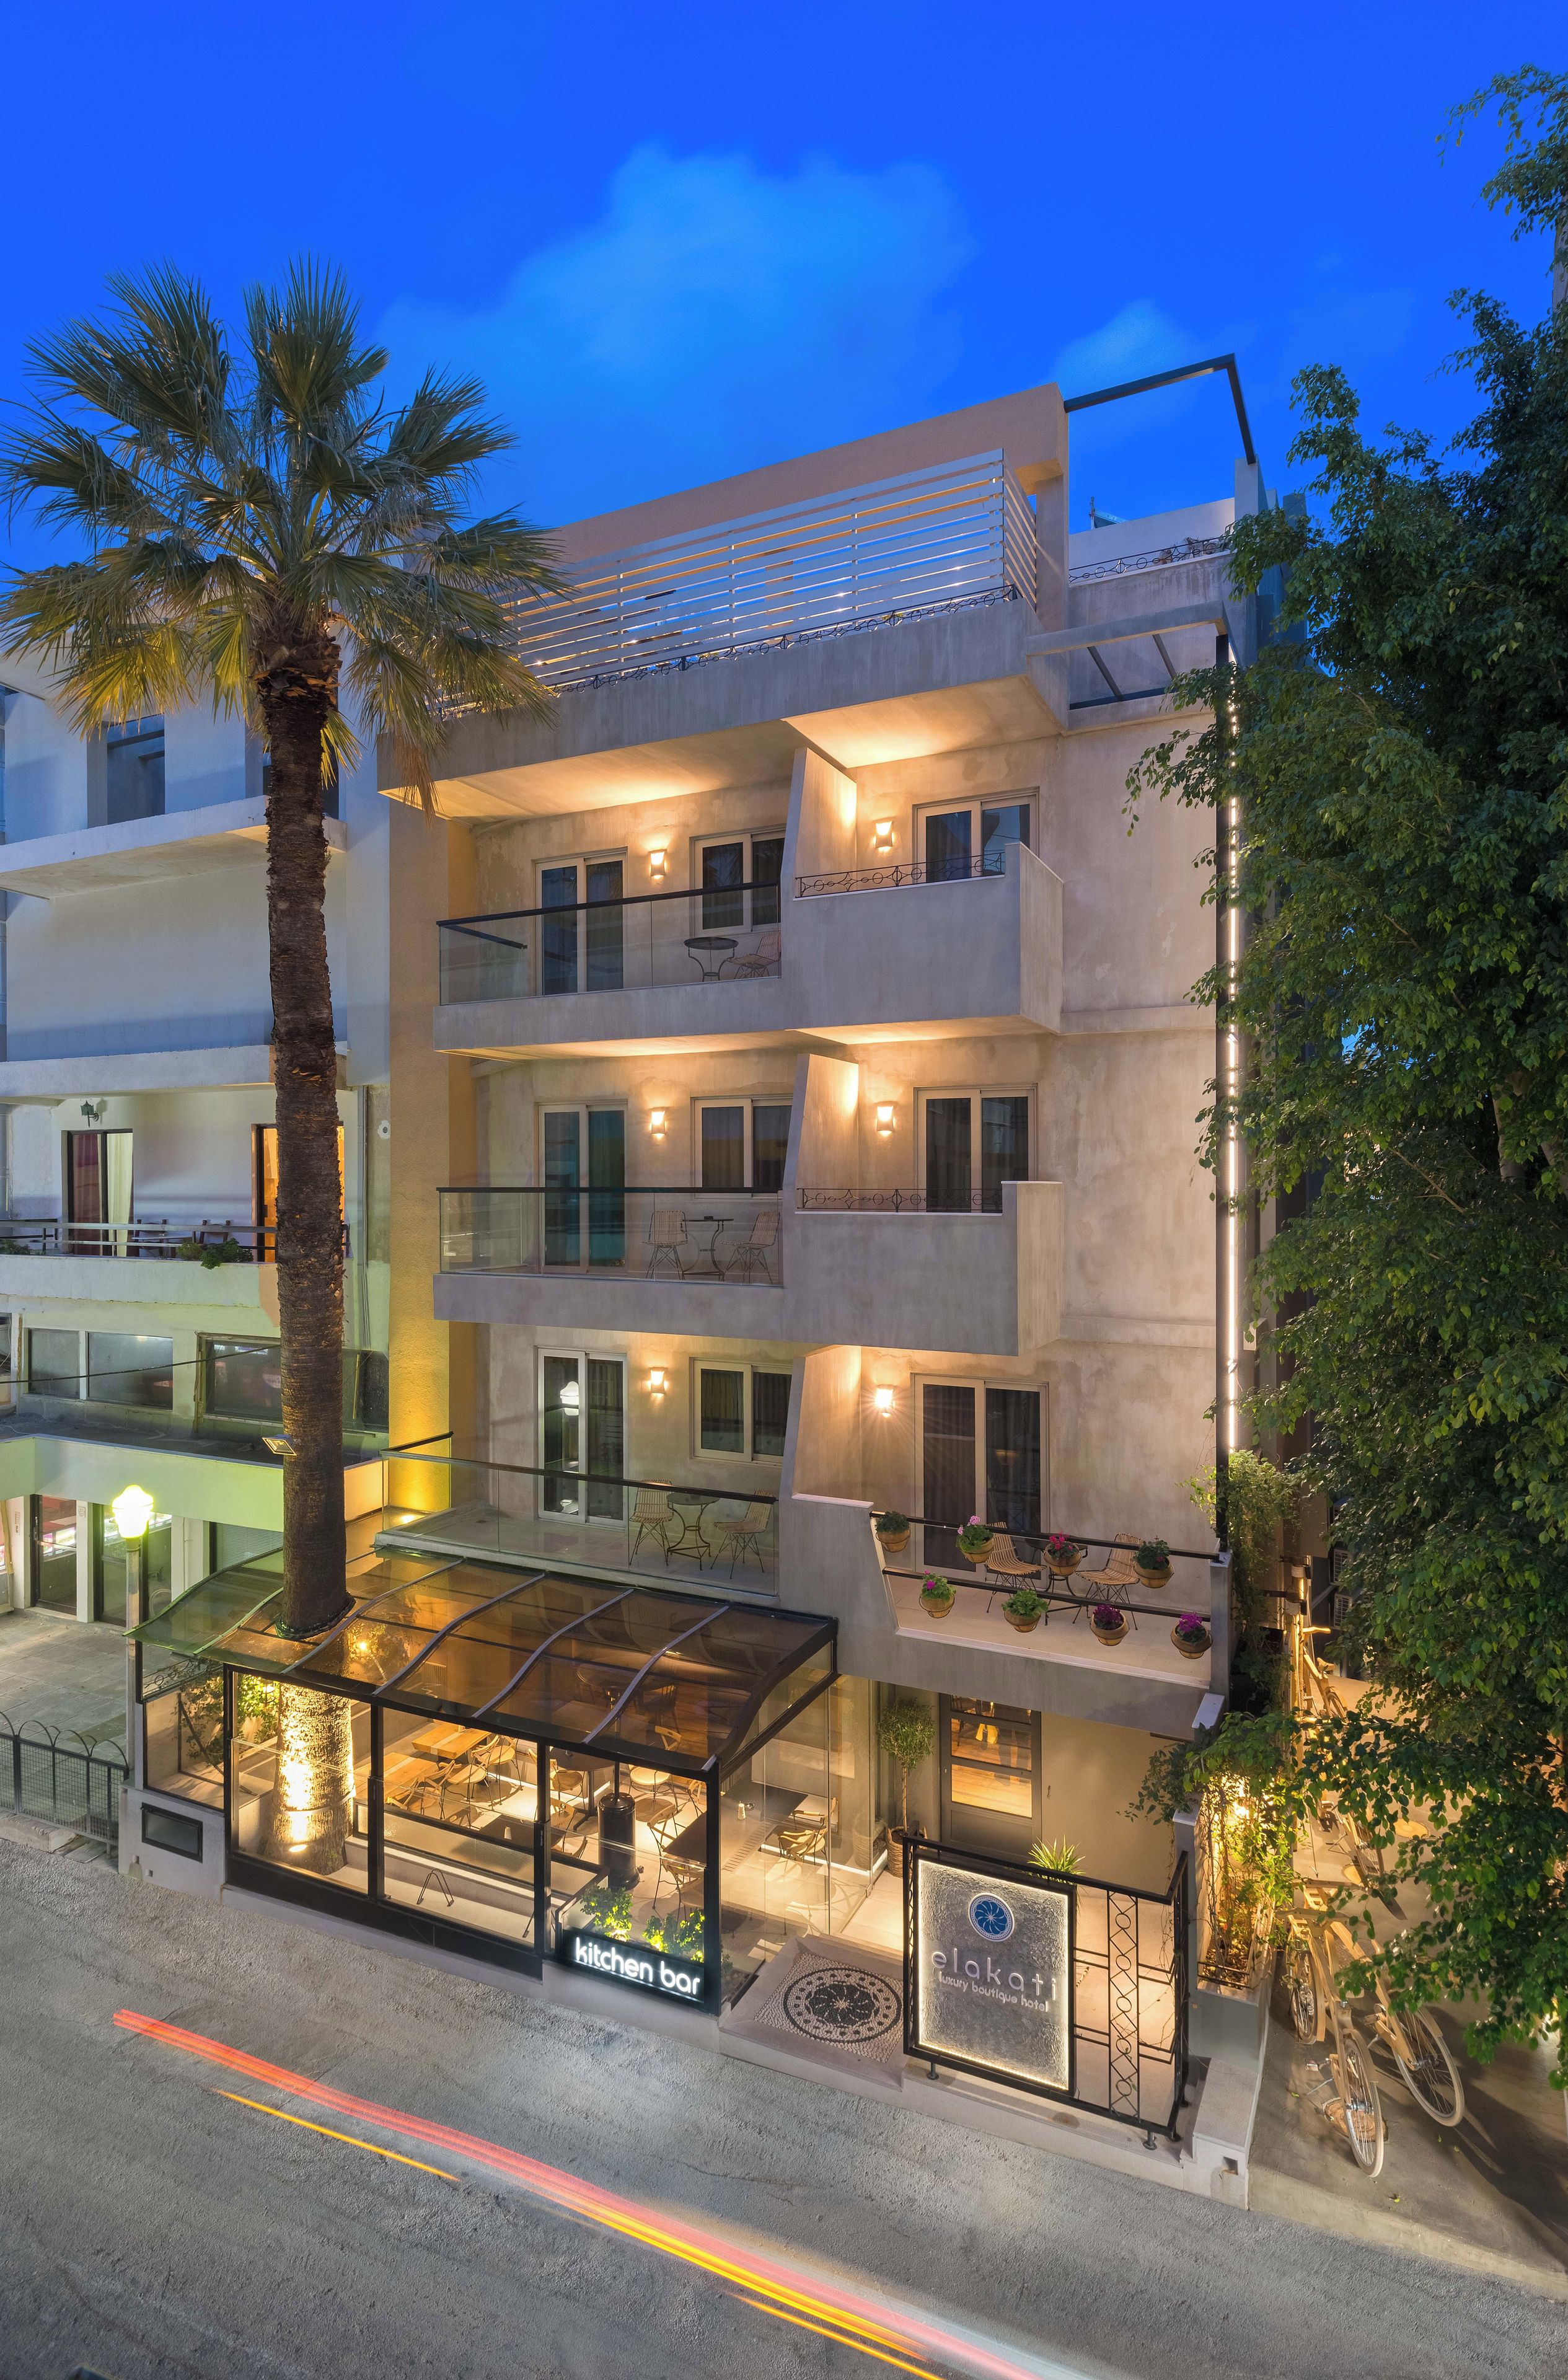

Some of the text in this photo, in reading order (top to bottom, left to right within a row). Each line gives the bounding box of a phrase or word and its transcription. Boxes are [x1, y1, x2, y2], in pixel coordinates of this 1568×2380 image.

[576, 1937, 700, 1994] kitchen bar
[932, 1947, 1056, 2001] elakati
[939, 1971, 1048, 2012] luxury boutique hotel
